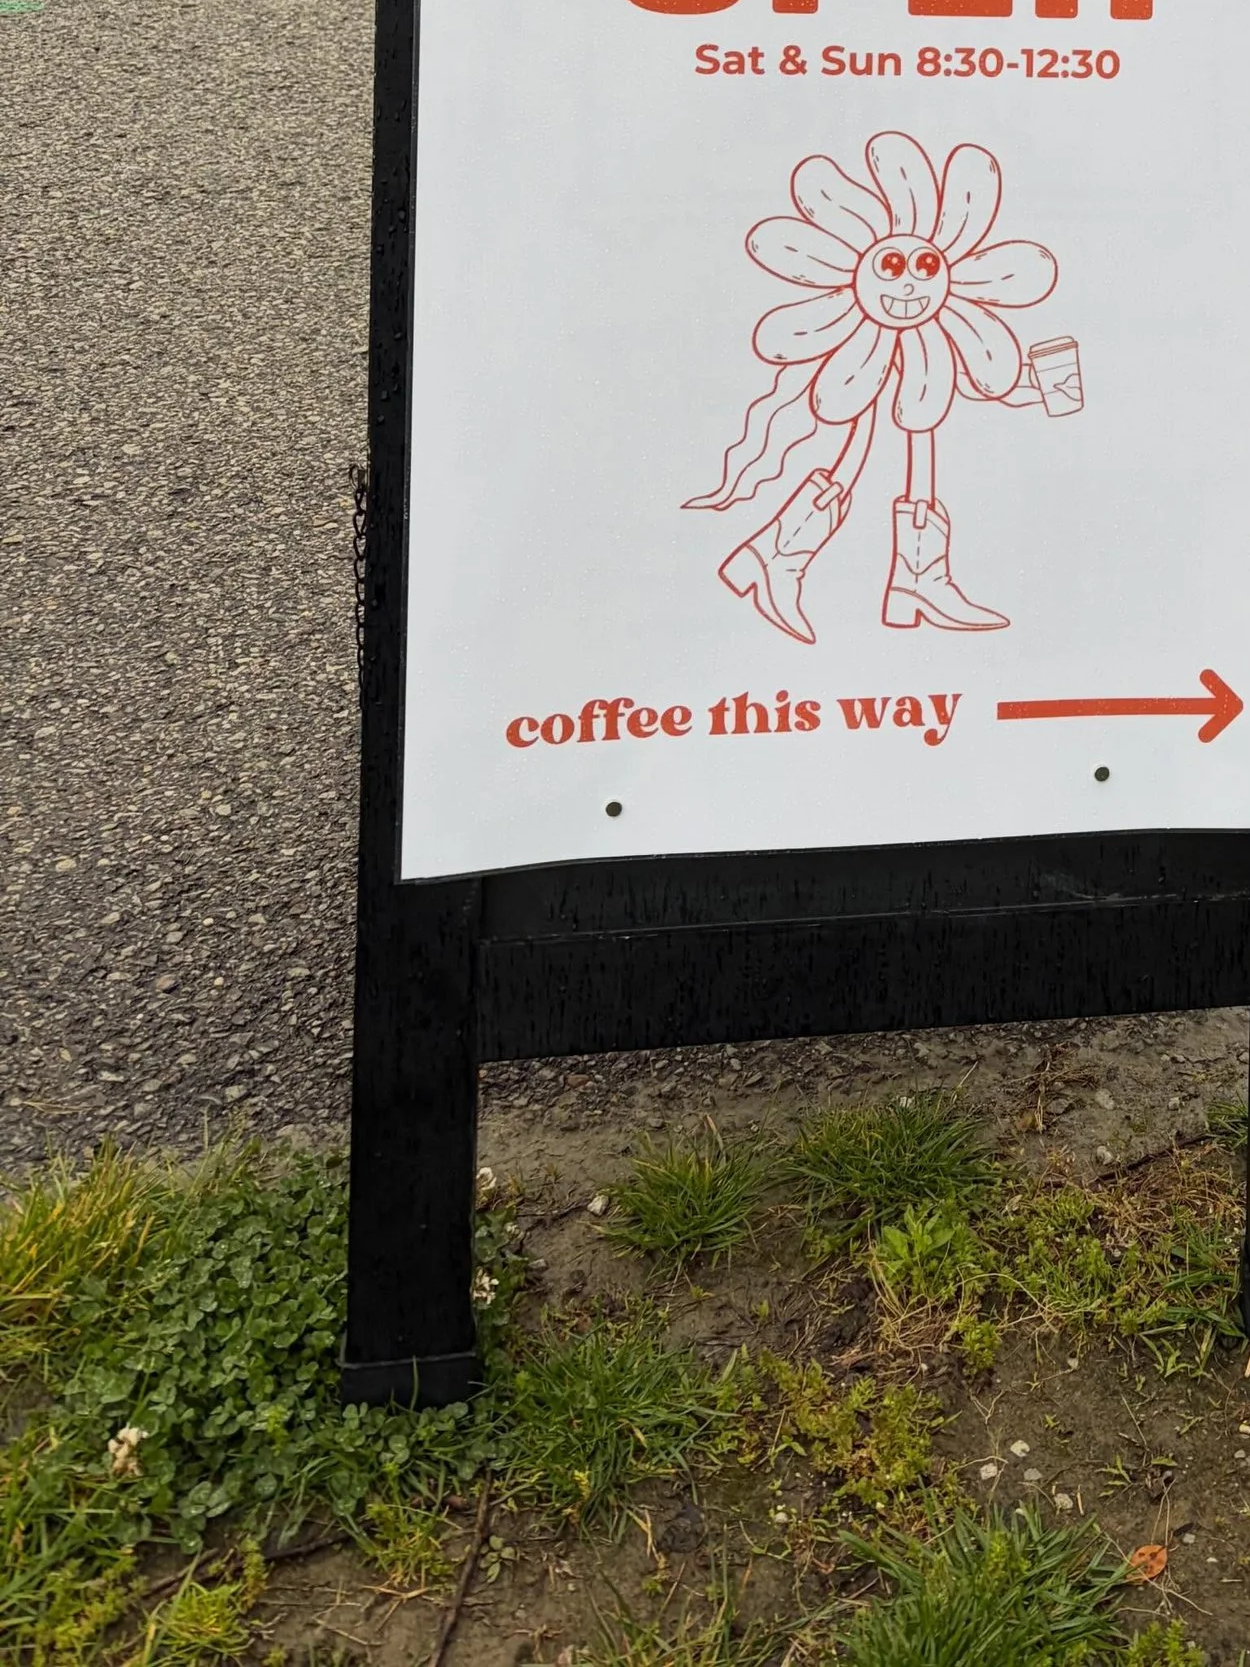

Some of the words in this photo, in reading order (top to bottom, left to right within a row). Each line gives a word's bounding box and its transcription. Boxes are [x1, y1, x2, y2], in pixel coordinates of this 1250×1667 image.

[694, 43, 765, 77] Sat
[778, 44, 808, 77] &
[820, 44, 902, 78] Sun
[915, 45, 1121, 81] 8:30-12:30
[504, 696, 693, 749] coffee
[707, 689, 821, 737] this
[837, 692, 961, 748] way
